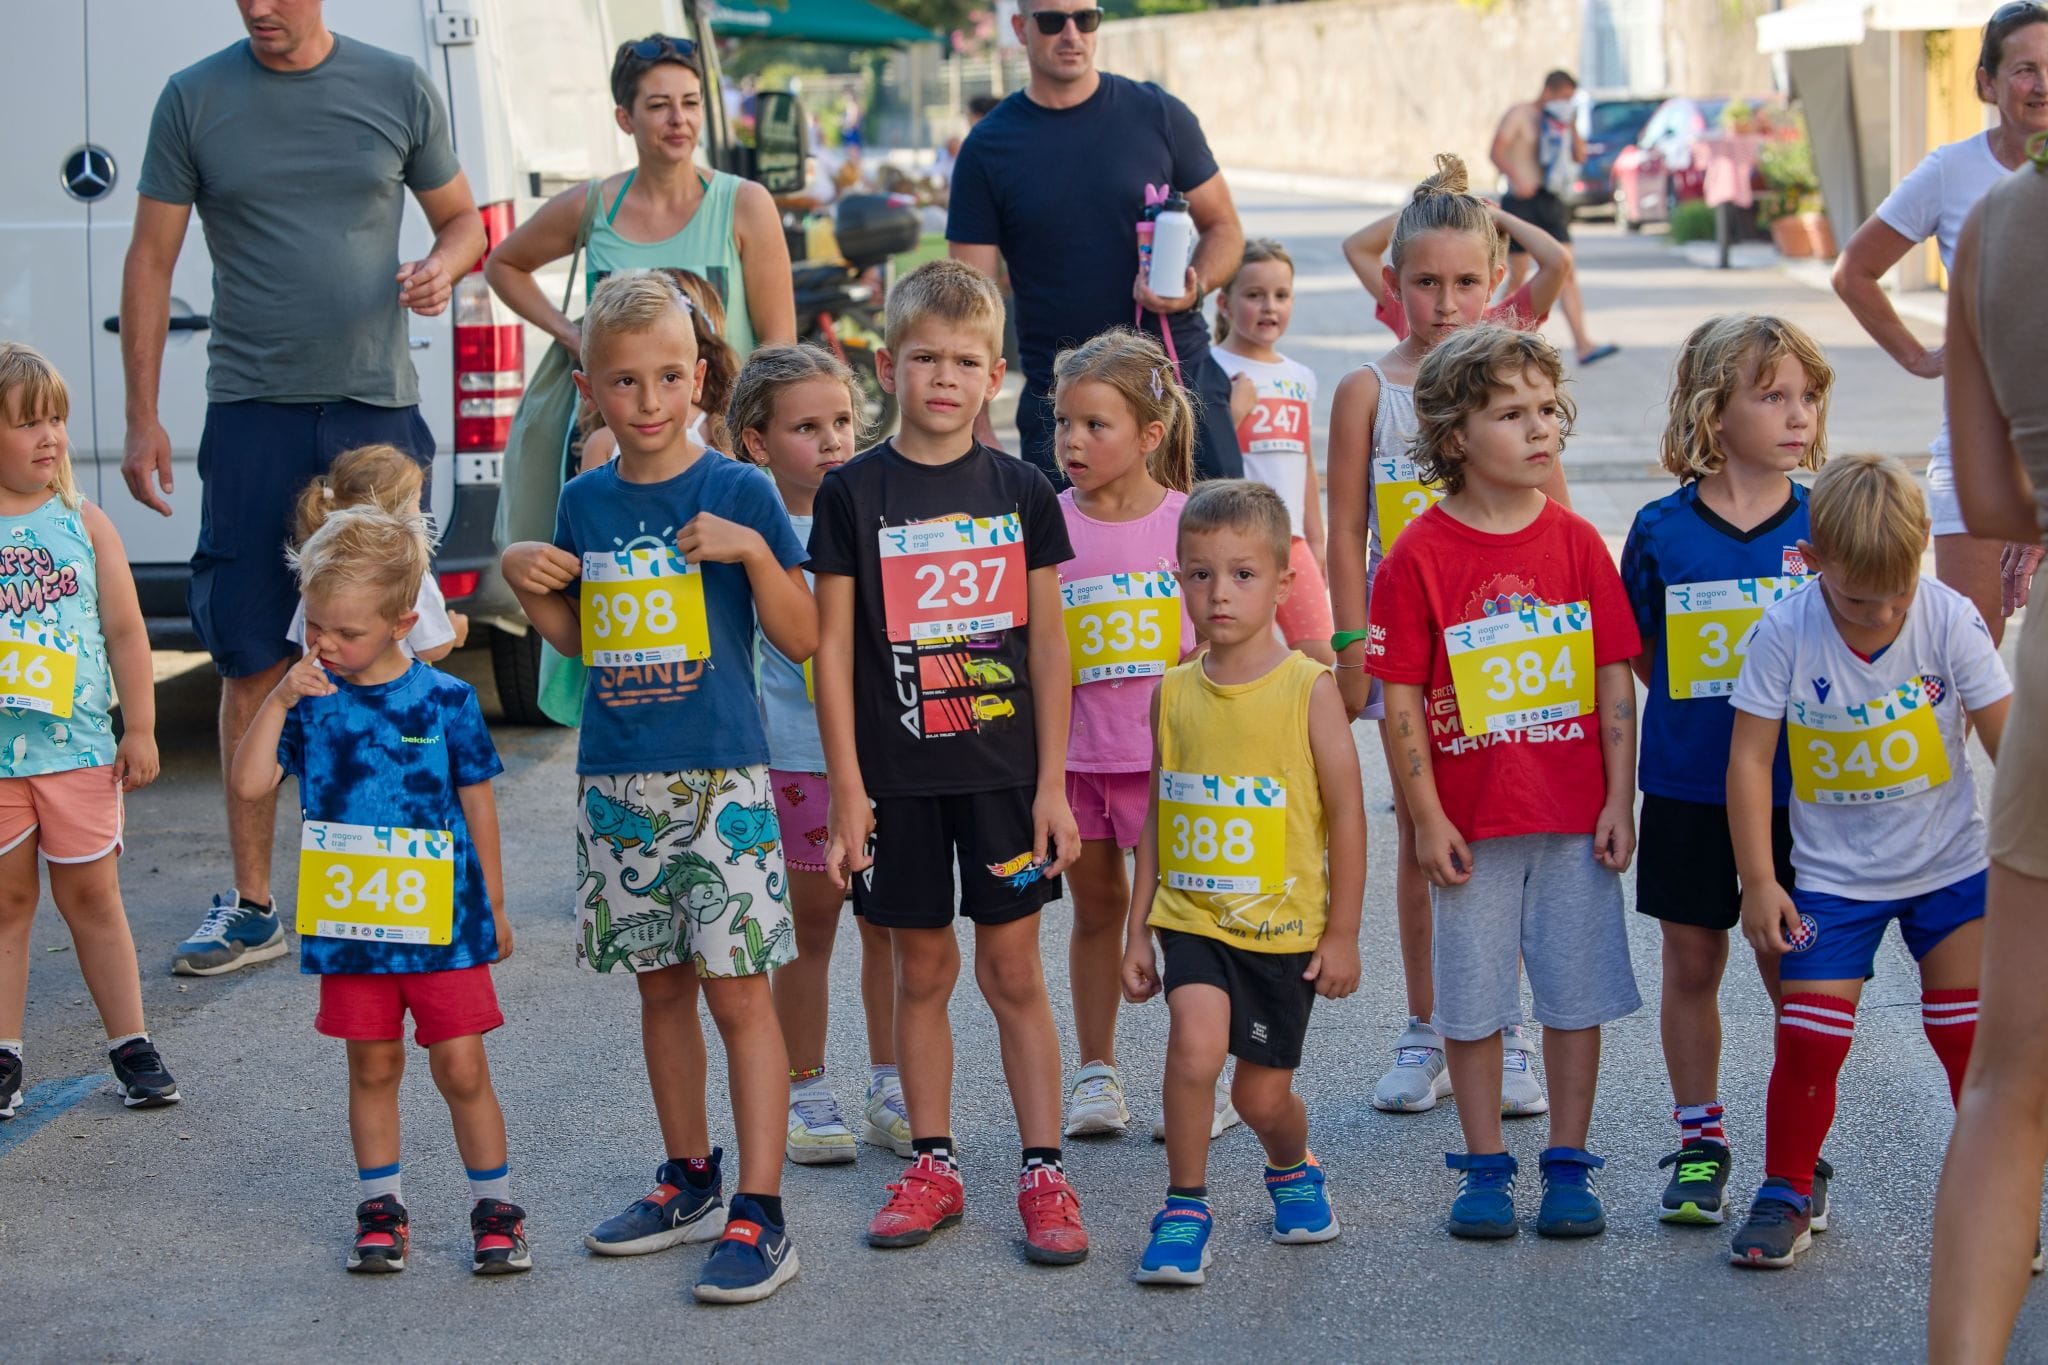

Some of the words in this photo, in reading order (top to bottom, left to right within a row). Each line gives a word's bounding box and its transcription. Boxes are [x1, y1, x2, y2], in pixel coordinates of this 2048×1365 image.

[1251, 404, 1301, 434] 247
[914, 557, 1007, 609] 237
[591, 589, 678, 638] 398
[1079, 609, 1162, 655] 335
[1479, 634, 1496, 643] trail
[600, 662, 704, 688] SAND
[1481, 645, 1576, 701] 384
[1432, 713, 1465, 736] M
[1437, 722, 1585, 756] HRVATSKA
[1807, 729, 1920, 780] 340
[1172, 814, 1255, 864] 388
[324, 863, 427, 914] 348
